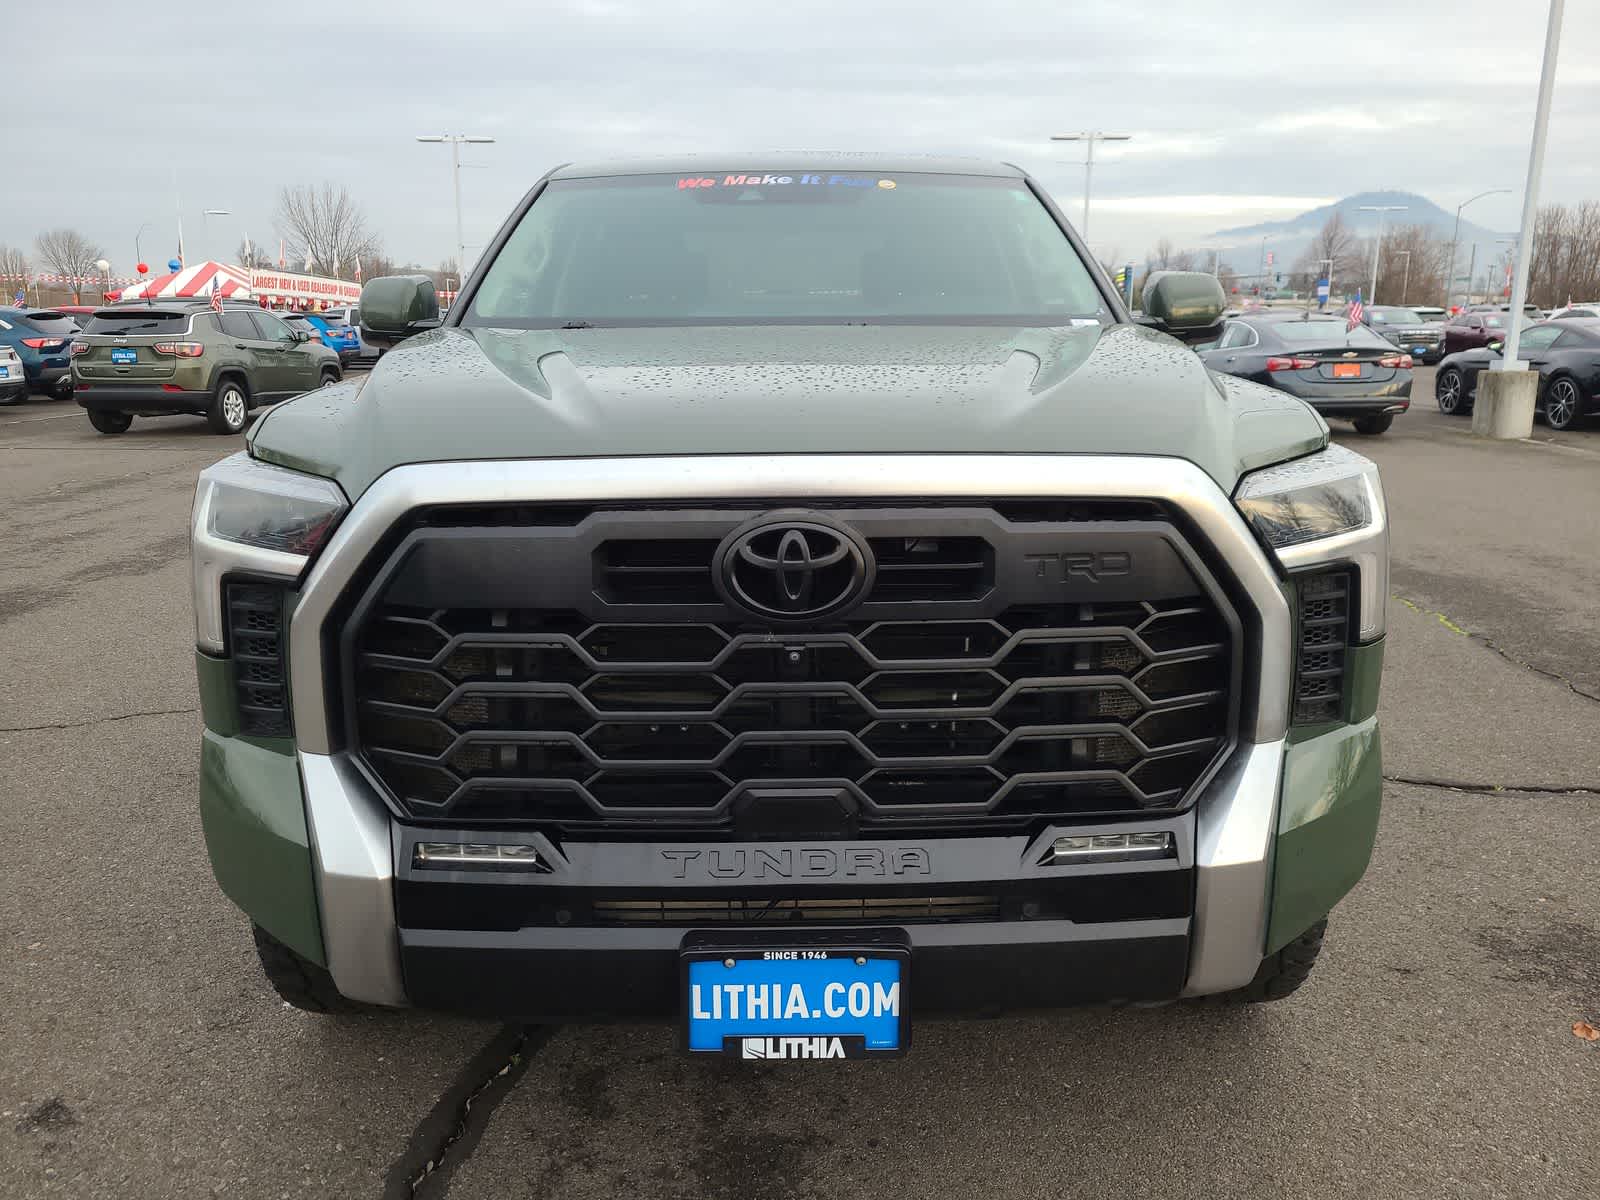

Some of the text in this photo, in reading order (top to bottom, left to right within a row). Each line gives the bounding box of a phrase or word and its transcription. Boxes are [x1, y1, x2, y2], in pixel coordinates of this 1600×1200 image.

[677, 177, 716, 189] We
[723, 174, 793, 186] Make
[800, 174, 820, 185] It
[252, 276, 277, 289] LARGEST
[279, 278, 291, 291] NEW
[1023, 552, 1135, 584] TRD
[661, 848, 932, 878] TUNDRA
[763, 951, 828, 960] SINCE 1946
[692, 982, 900, 1019] LITHIA.COM
[766, 1037, 846, 1059] LITHIA
